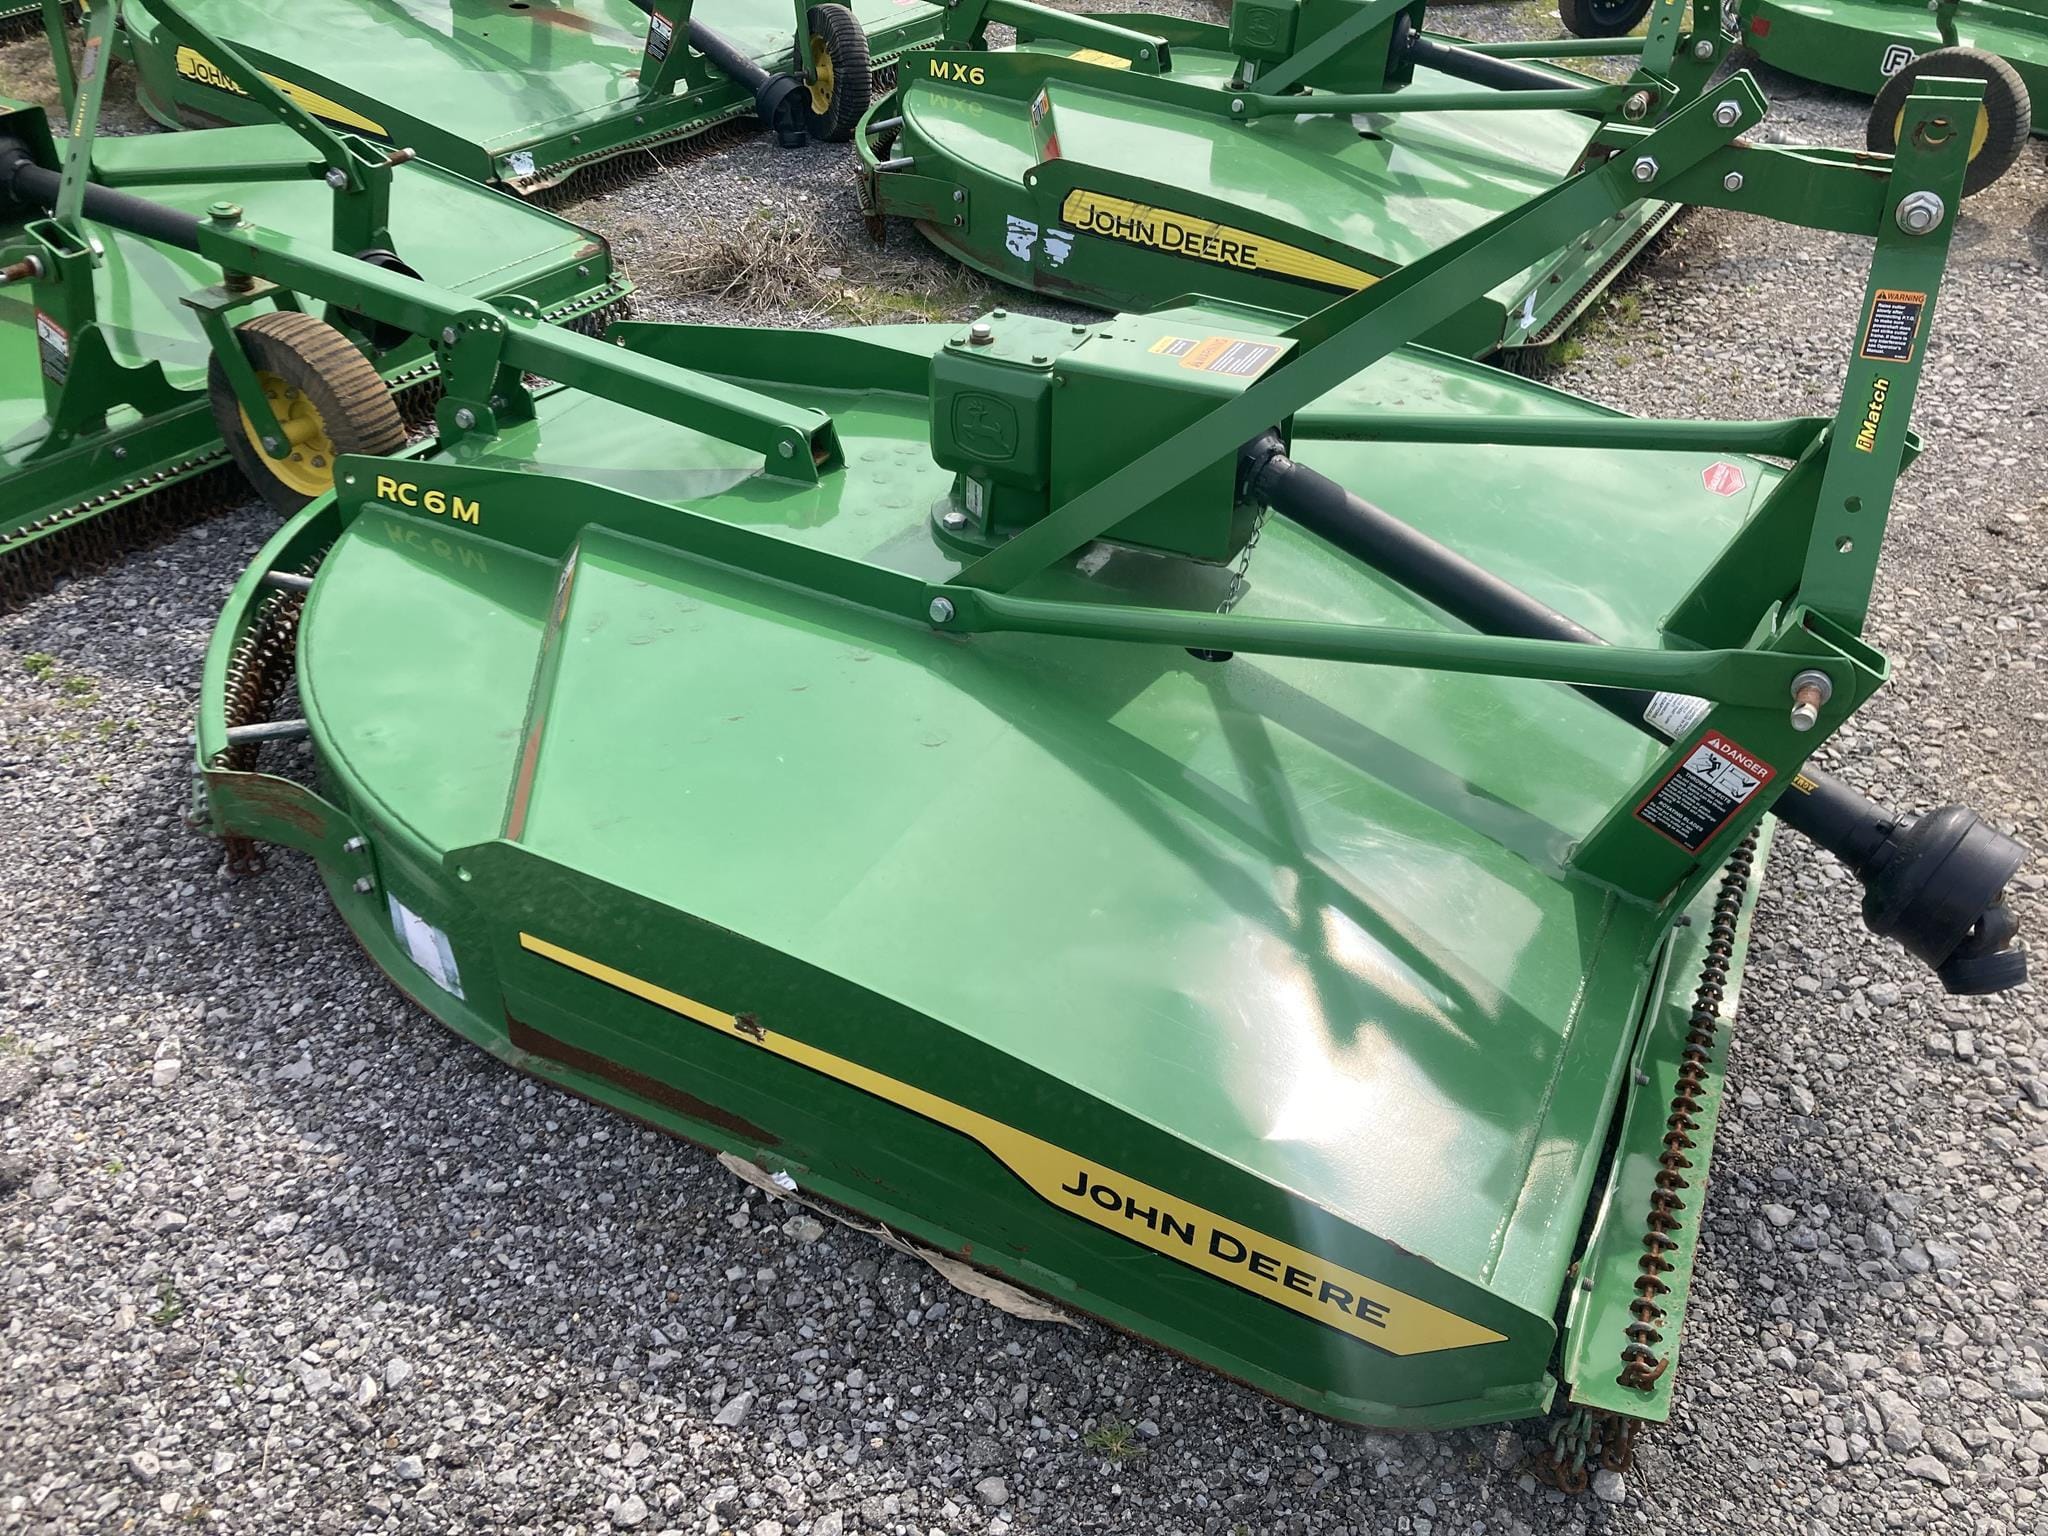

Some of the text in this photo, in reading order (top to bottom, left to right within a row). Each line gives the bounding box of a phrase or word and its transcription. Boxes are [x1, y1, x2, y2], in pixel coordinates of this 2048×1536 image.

[930, 59, 985, 85] MX6
[1078, 204, 1259, 266] JOHN DEERE
[1887, 293, 1924, 303] WARNING
[1855, 378, 1890, 453] iMatch
[1720, 744, 1768, 778] DANGER
[1062, 1171, 1391, 1329] JOHN DEERE
